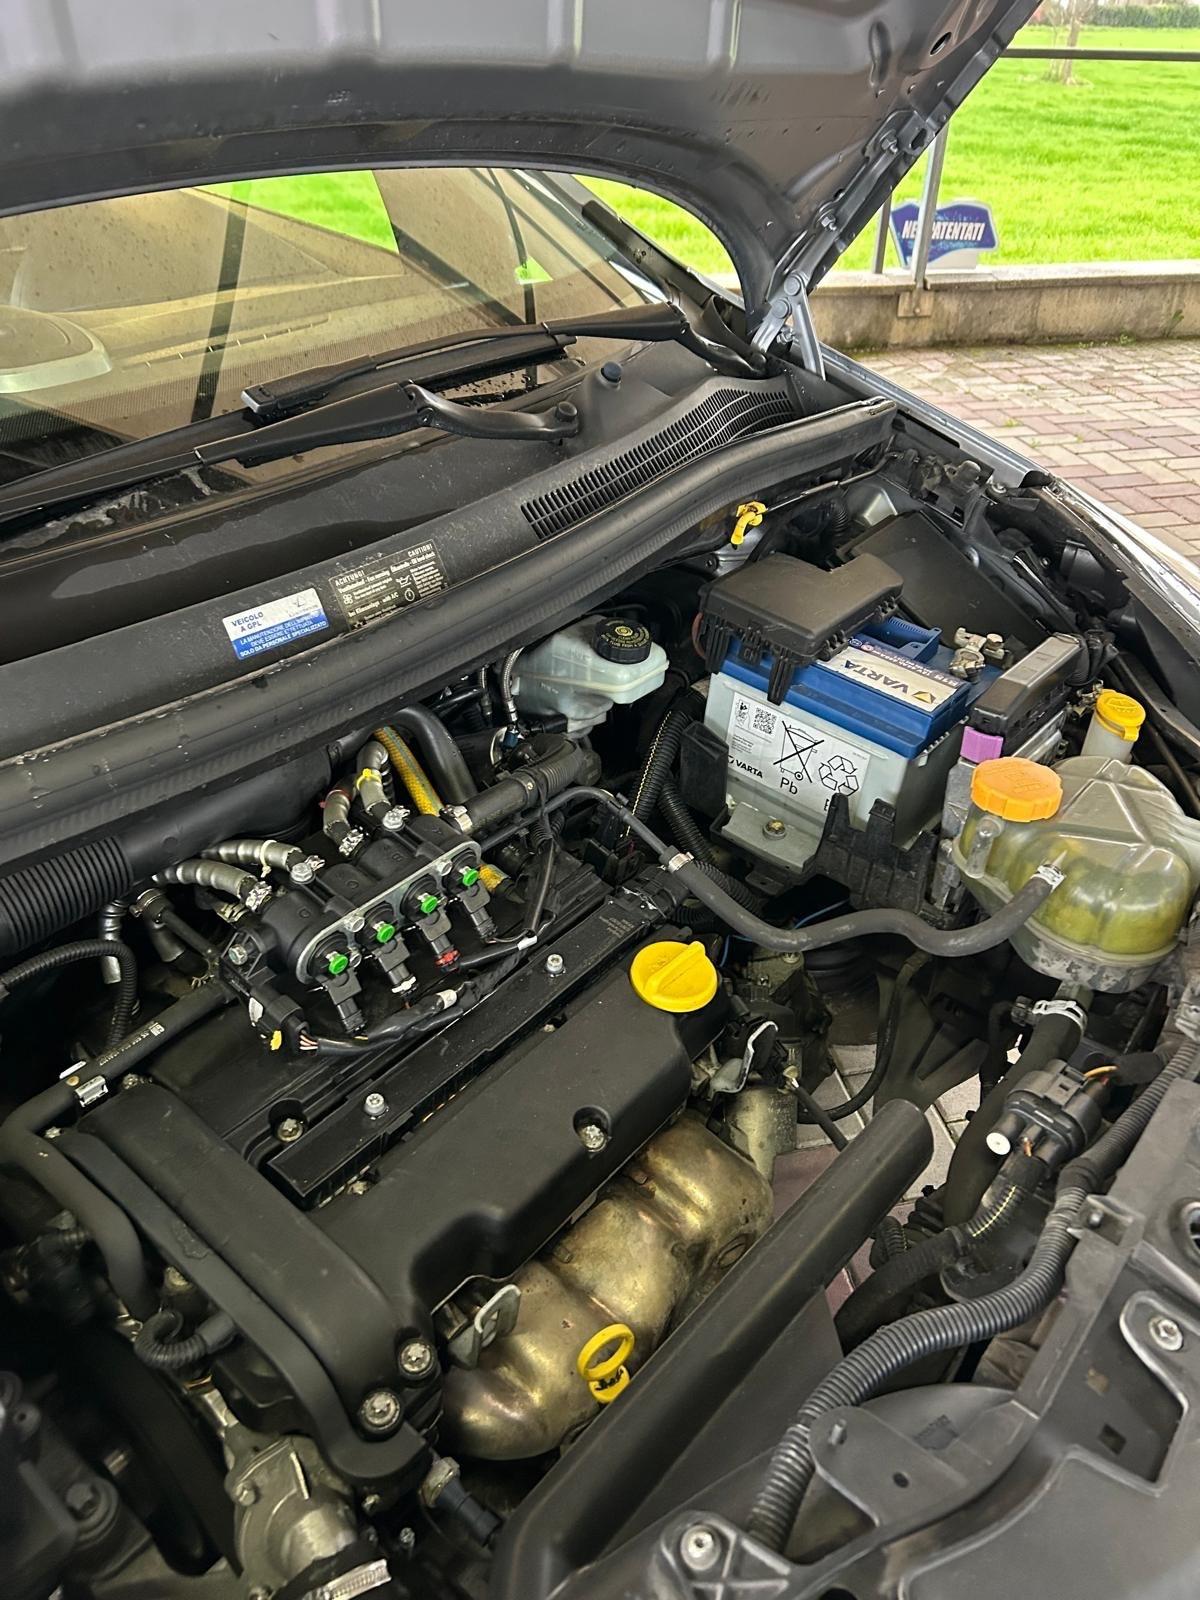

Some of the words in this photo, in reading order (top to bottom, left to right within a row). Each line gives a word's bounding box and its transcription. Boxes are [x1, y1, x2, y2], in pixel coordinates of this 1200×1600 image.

[901, 220, 985, 241] NEATENTATI
[407, 543, 433, 557] CAUTION!
[334, 569, 365, 586] ACHTUNG!
[231, 611, 264, 627] VEICOLO
[247, 621, 262, 630] GPL
[844, 660, 909, 693] VARTA
[736, 759, 763, 779] VARTA
[780, 777, 798, 795] Pb
